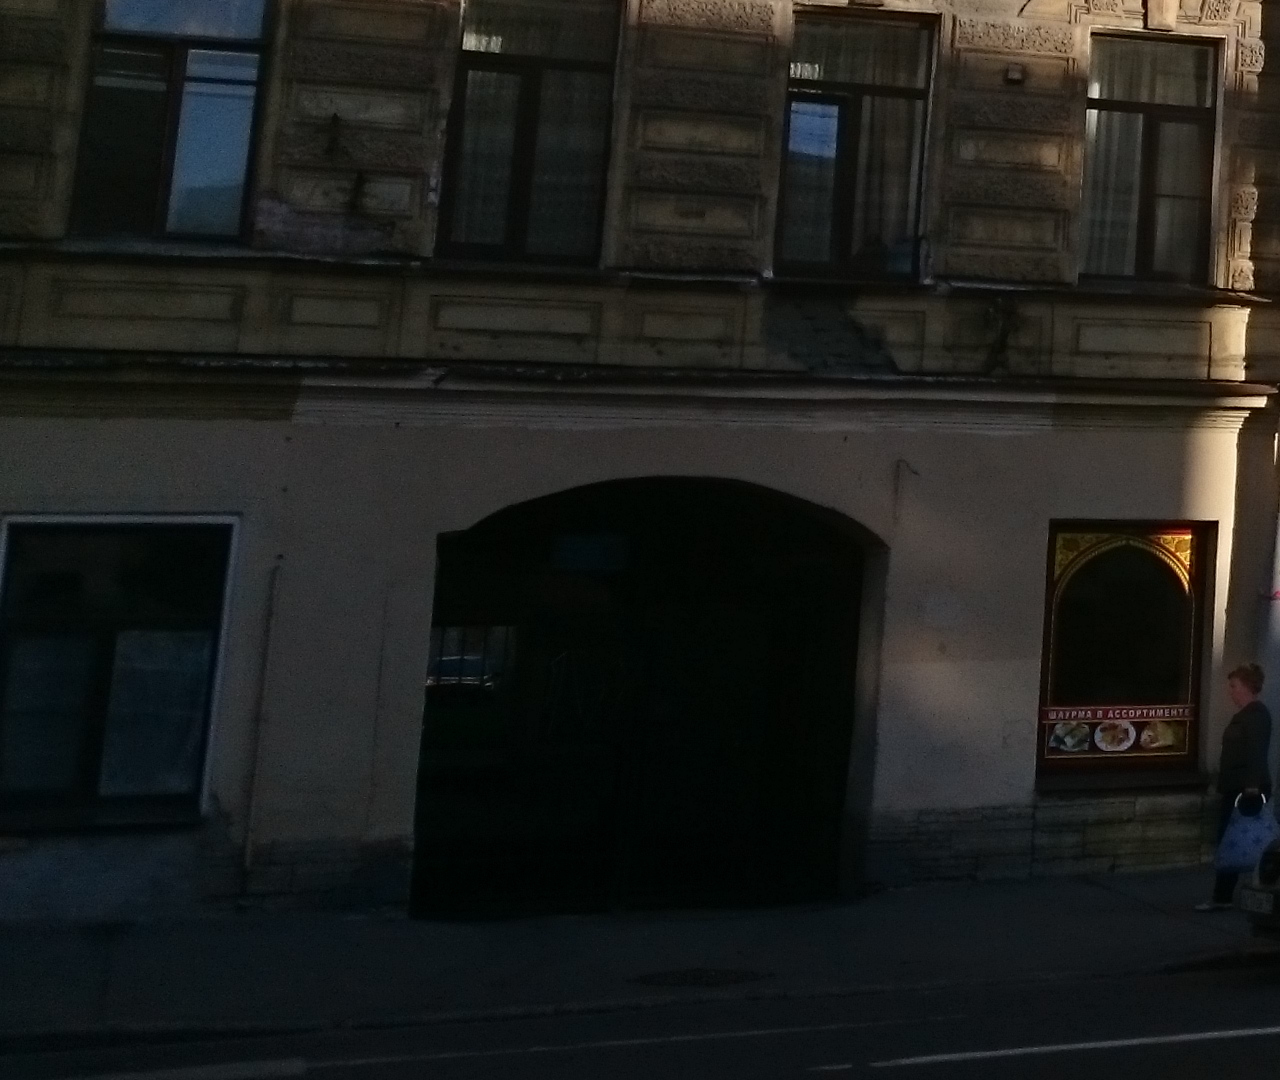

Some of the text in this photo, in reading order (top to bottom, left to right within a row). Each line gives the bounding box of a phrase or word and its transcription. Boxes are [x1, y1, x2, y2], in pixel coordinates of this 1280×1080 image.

[1048, 707, 1190, 720] ШАУРМА В АССОРТИМЕНТЕ
